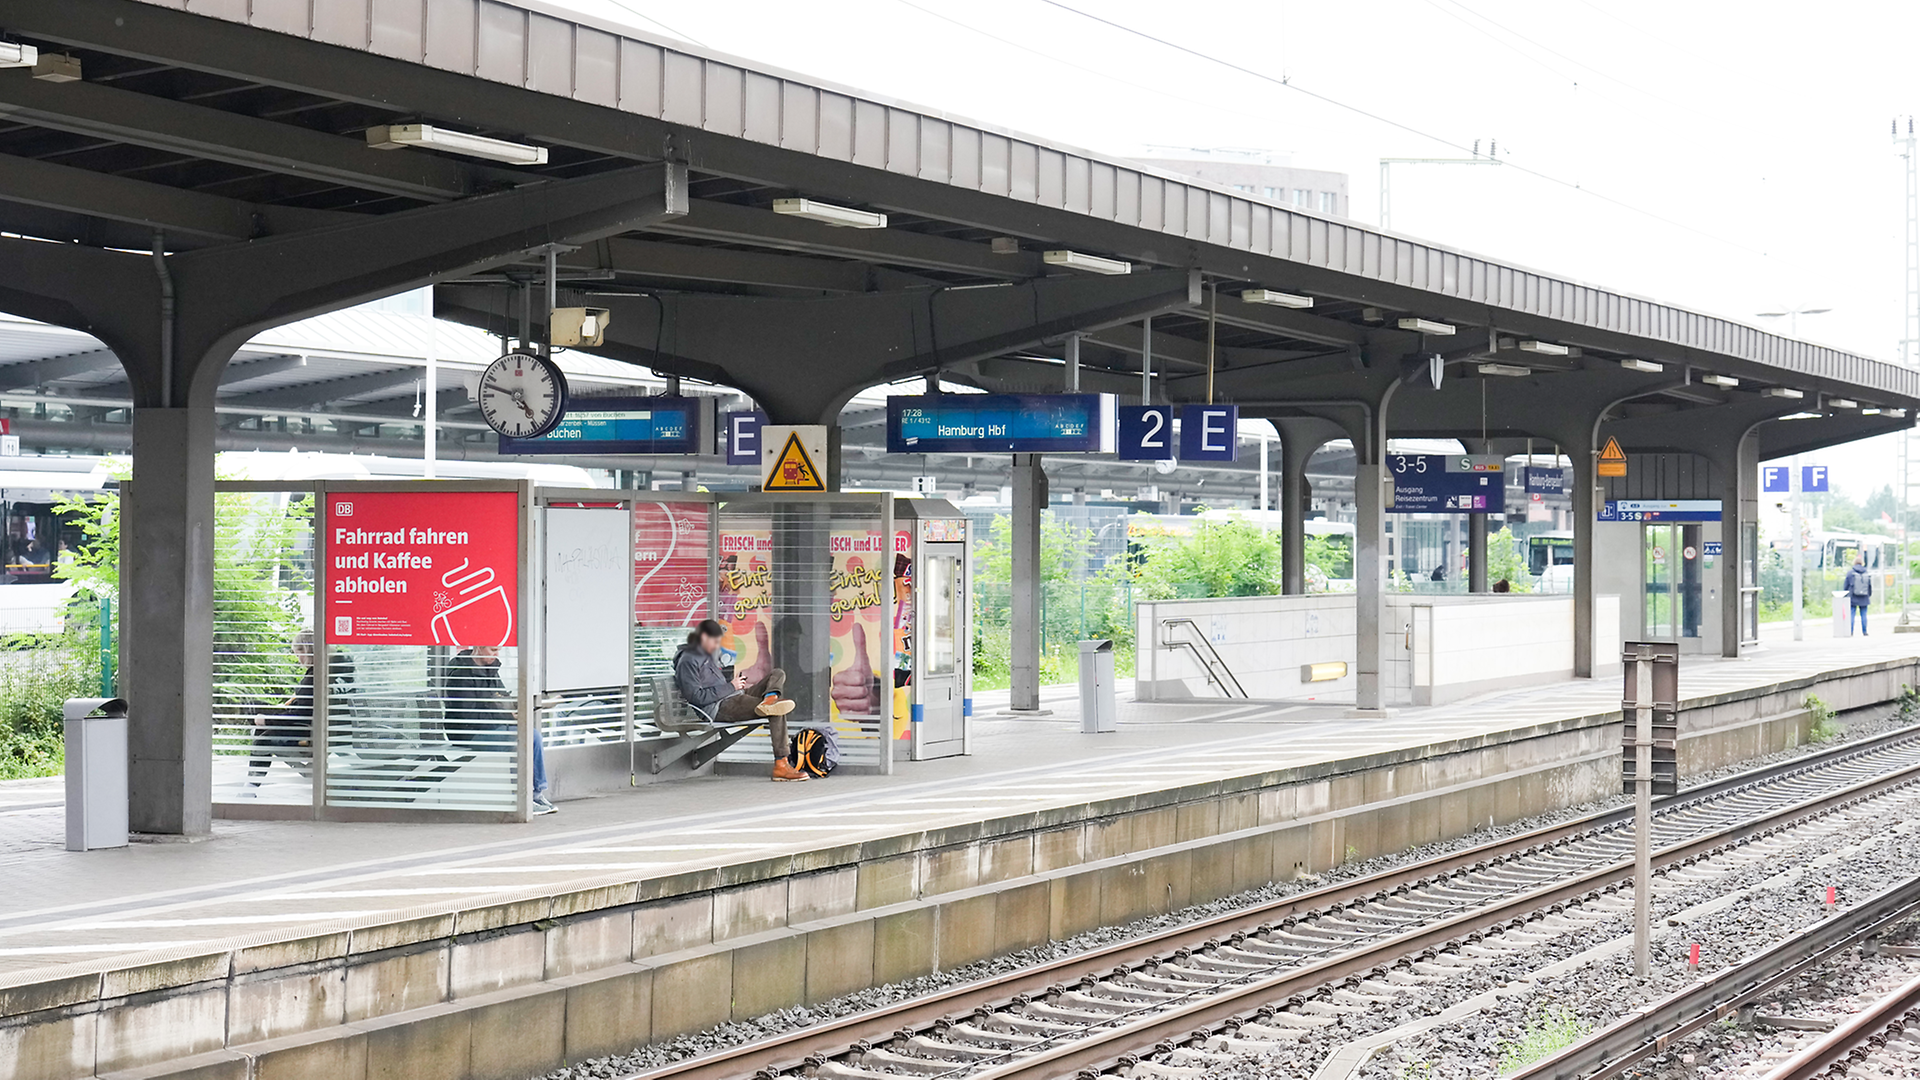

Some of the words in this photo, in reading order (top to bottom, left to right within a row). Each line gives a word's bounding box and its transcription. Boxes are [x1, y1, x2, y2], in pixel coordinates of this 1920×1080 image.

[902, 409, 922, 417] 17:28
[733, 416, 756, 456] E
[938, 425, 985, 438] Hamburg
[988, 425, 1006, 436] Hbf
[1140, 409, 1165, 448] 2
[1201, 410, 1227, 451] E
[1395, 455, 1427, 474] 3-5
[1460, 458, 1471, 470] S
[1765, 467, 1779, 488] F
[1812, 467, 1825, 487] F
[1395, 486, 1424, 495] Ausgang
[337, 503, 352, 515] DB
[1620, 512, 1634, 520] 3-5
[335, 528, 405, 544] Fahrrad
[409, 528, 469, 544] fahren
[723, 536, 755, 551] FRISCH
[854, 537, 871, 551] und
[335, 552, 369, 569] und
[373, 552, 433, 569] Kaffee
[634, 550, 657, 561] ern
[334, 576, 408, 593] abholen
